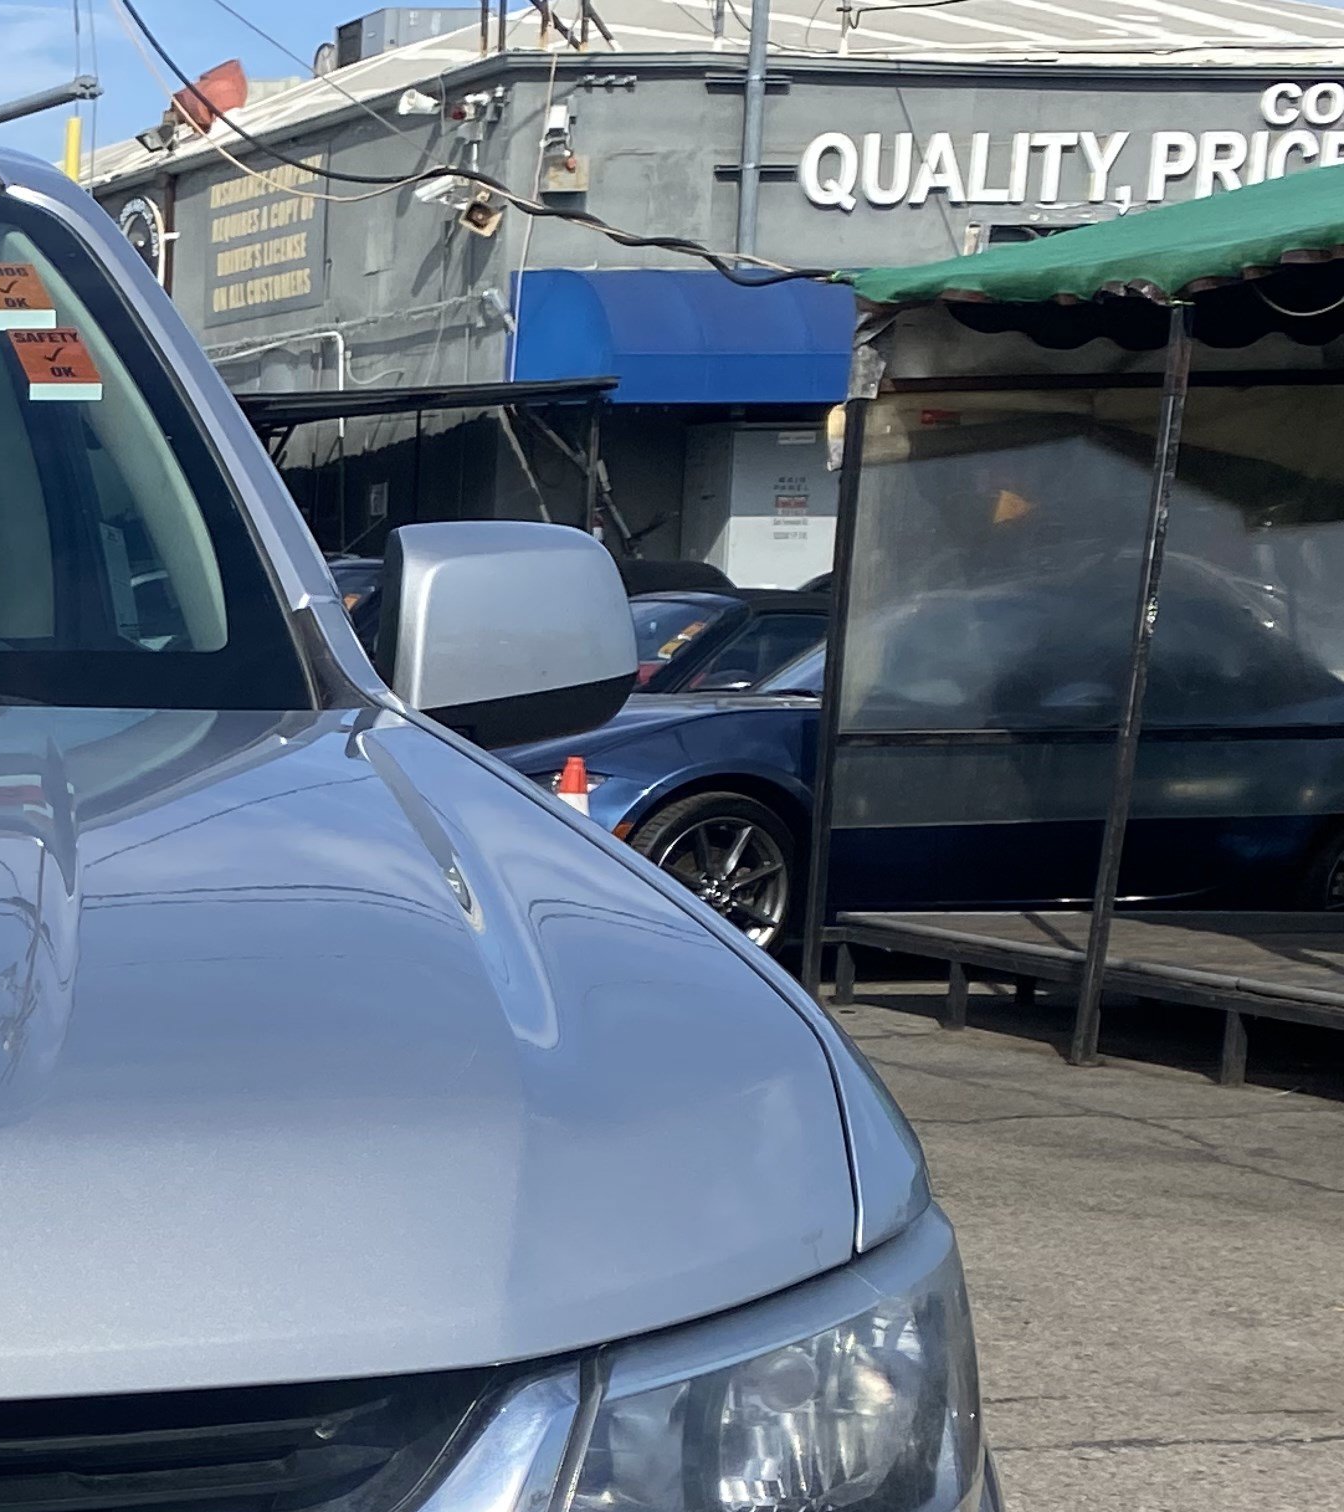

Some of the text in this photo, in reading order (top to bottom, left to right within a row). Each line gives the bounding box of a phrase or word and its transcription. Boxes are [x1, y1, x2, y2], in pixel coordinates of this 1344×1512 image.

[1260, 82, 1344, 125] CO
[210, 170, 269, 209] INSURANCE
[798, 130, 1131, 215] QUALITY,
[211, 196, 315, 243] REQUIRES A COPY OF
[217, 232, 308, 277] DRIVER'S LICENSE
[3, 297, 31, 308] OK
[213, 267, 311, 312] ON ALL CUSTOMERS
[13, 332, 79, 343] SAFETY
[50, 366, 77, 377] OK
